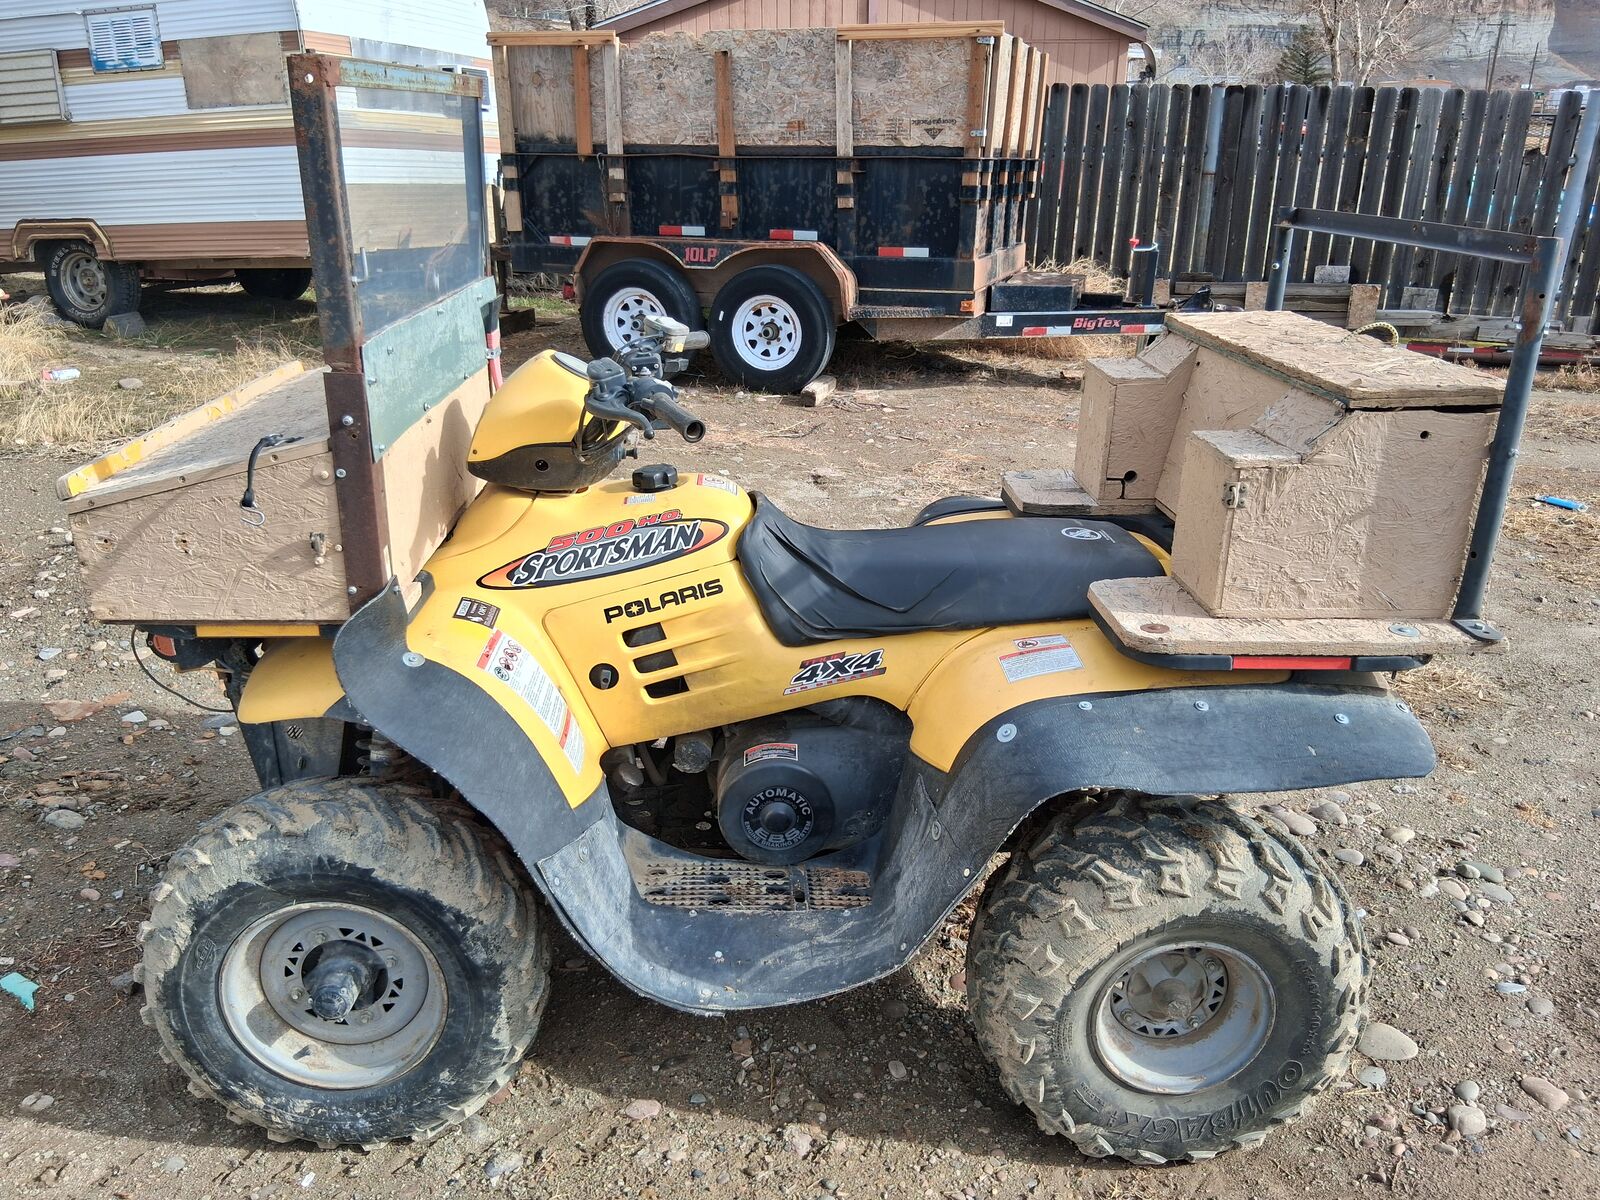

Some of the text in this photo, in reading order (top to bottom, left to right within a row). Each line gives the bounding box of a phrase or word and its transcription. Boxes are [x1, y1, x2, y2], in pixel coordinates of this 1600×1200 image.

[685, 247, 718, 262] 10LP
[1072, 317, 1121, 330] BigTex
[547, 519, 637, 553] 500
[511, 520, 702, 587] SPORTSMAN
[603, 578, 724, 624] POLARIS
[745, 788, 811, 816] AUTOMATIC
[754, 827, 801, 843] EBS
[1108, 1059, 1304, 1144] OUTBACK
